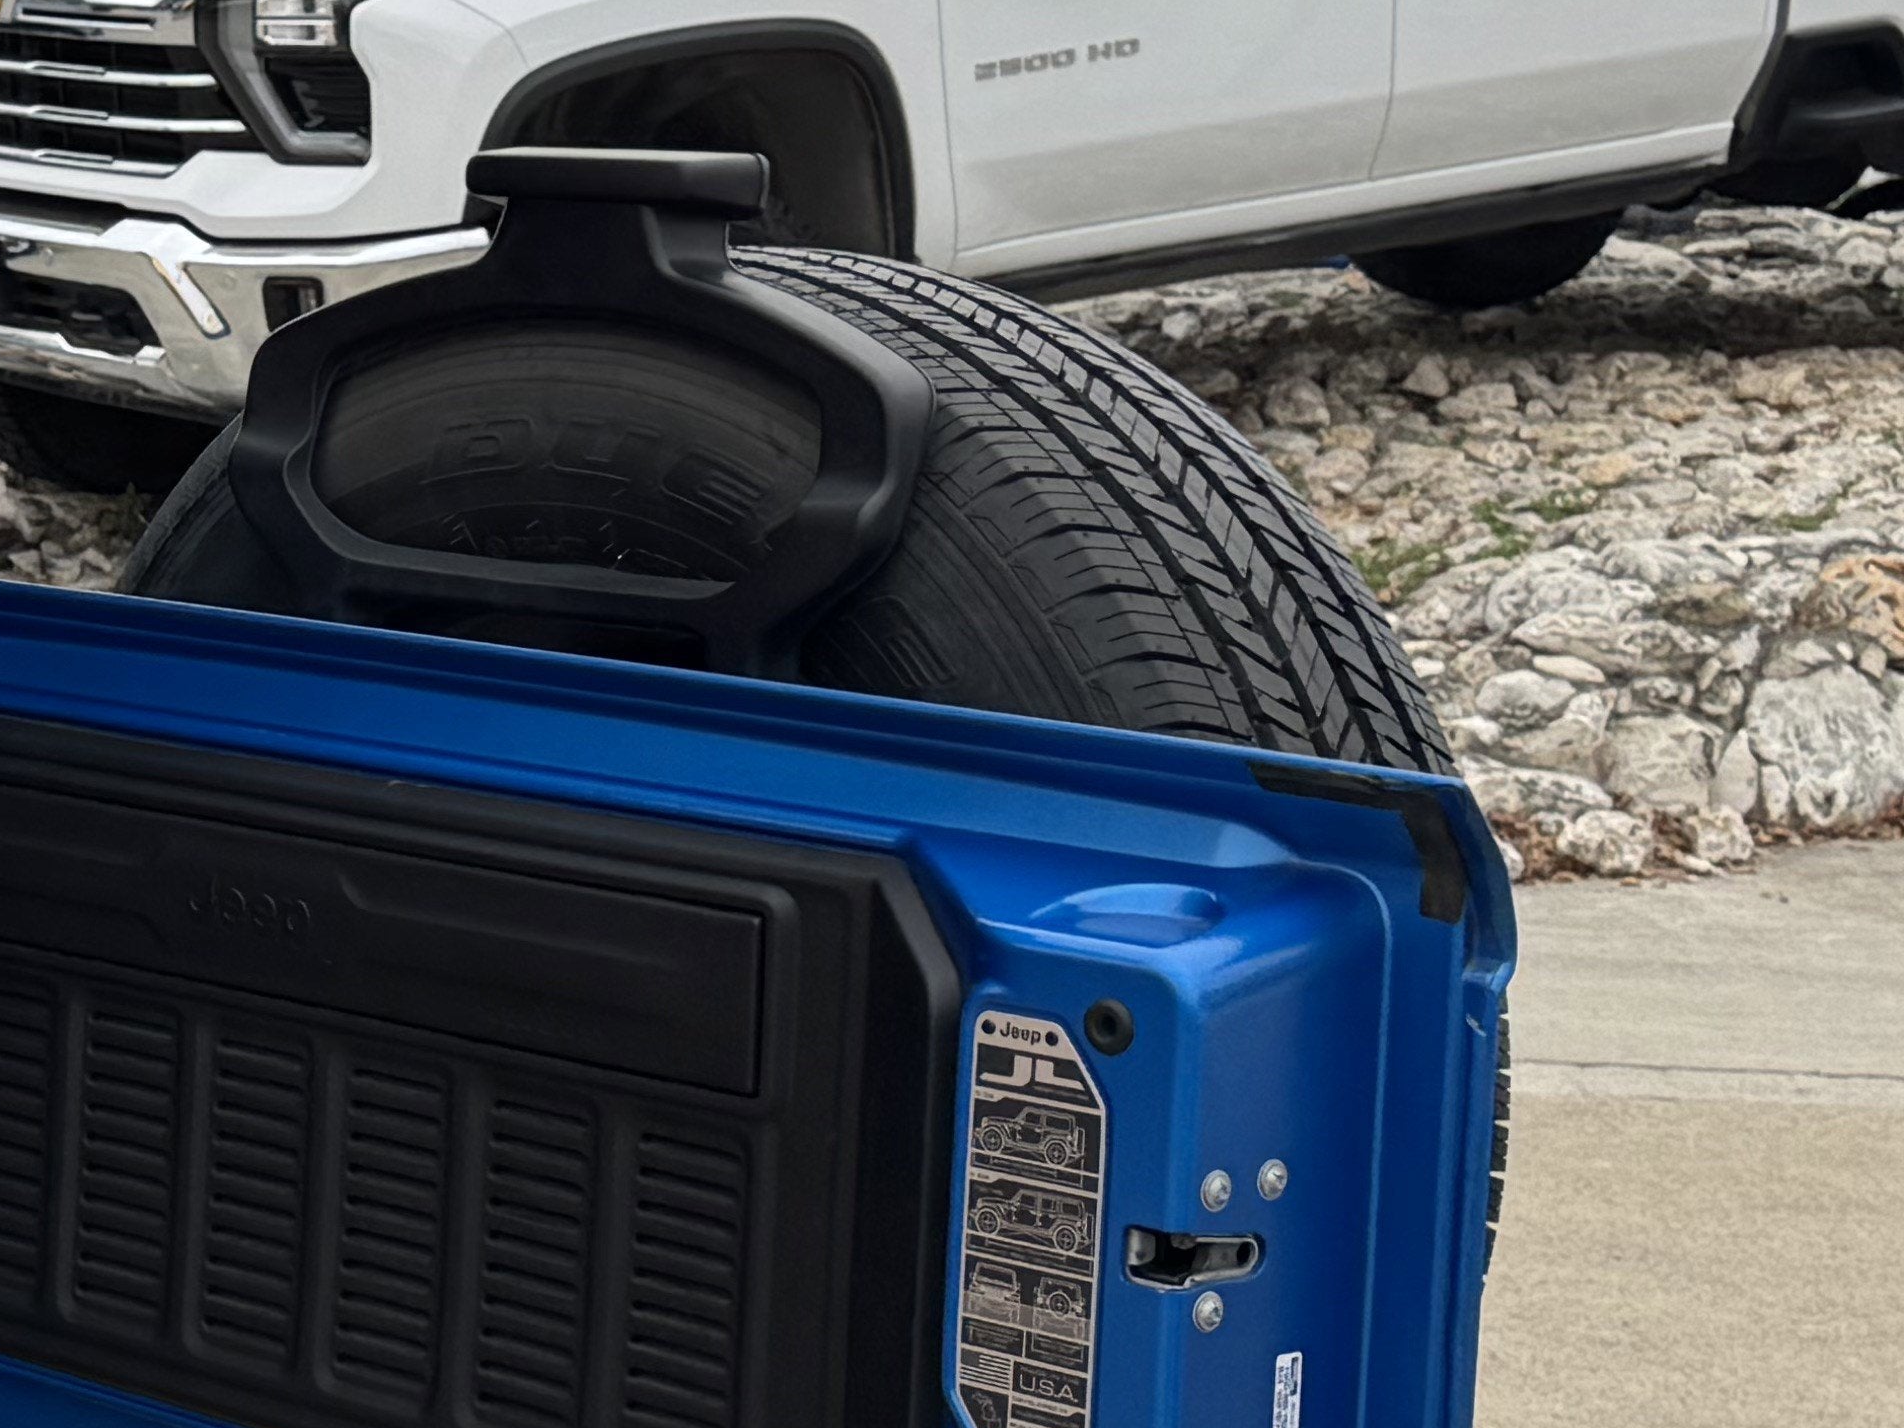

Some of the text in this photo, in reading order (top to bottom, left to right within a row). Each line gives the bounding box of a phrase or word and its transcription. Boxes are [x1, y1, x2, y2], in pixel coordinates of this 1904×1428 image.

[974, 38, 1140, 82] 2500 HD
[1000, 1021, 1042, 1046] Jeep
[979, 1054, 1086, 1091] JL
[1019, 1373, 1079, 1403] U.S.A.
